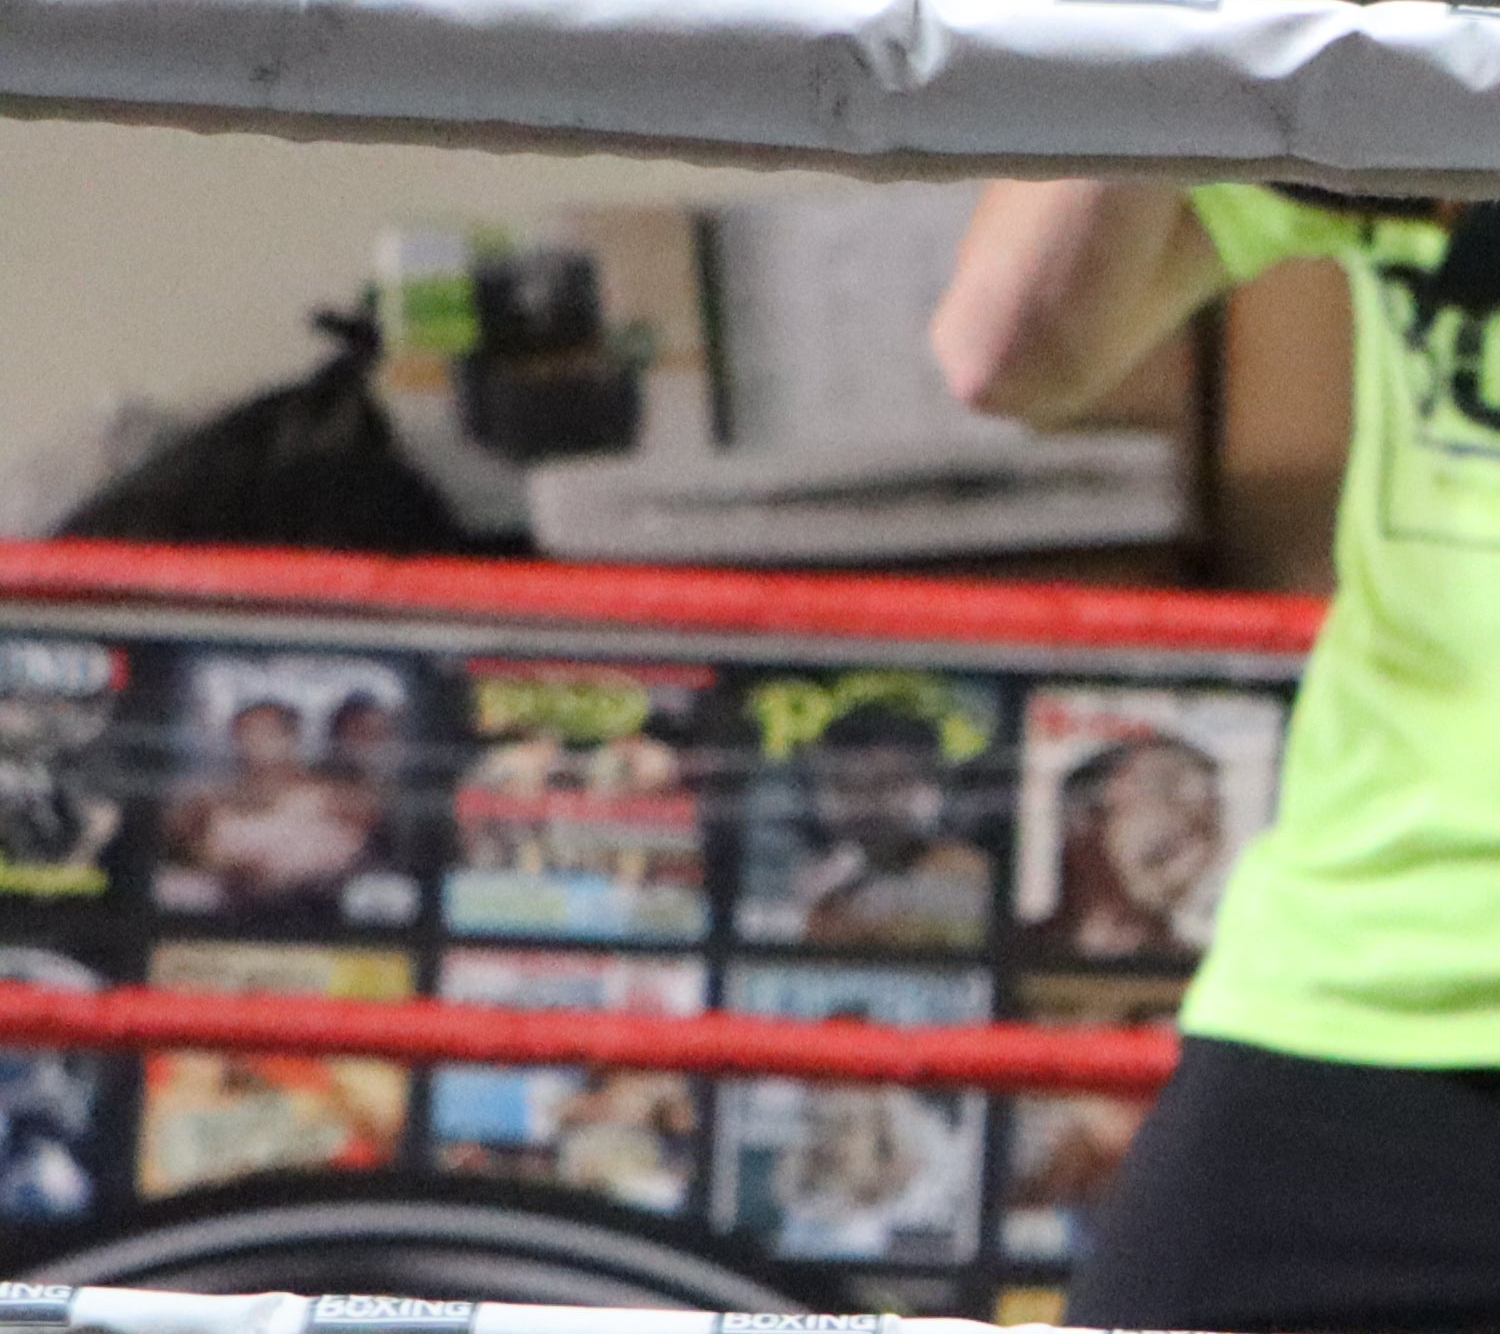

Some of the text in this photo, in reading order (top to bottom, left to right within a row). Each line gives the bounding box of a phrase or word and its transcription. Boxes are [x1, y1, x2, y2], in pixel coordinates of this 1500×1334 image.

[0, 1282, 71, 1299] ING
[316, 1296, 472, 1316] BOXING
[722, 1313, 875, 1331] BOXING
